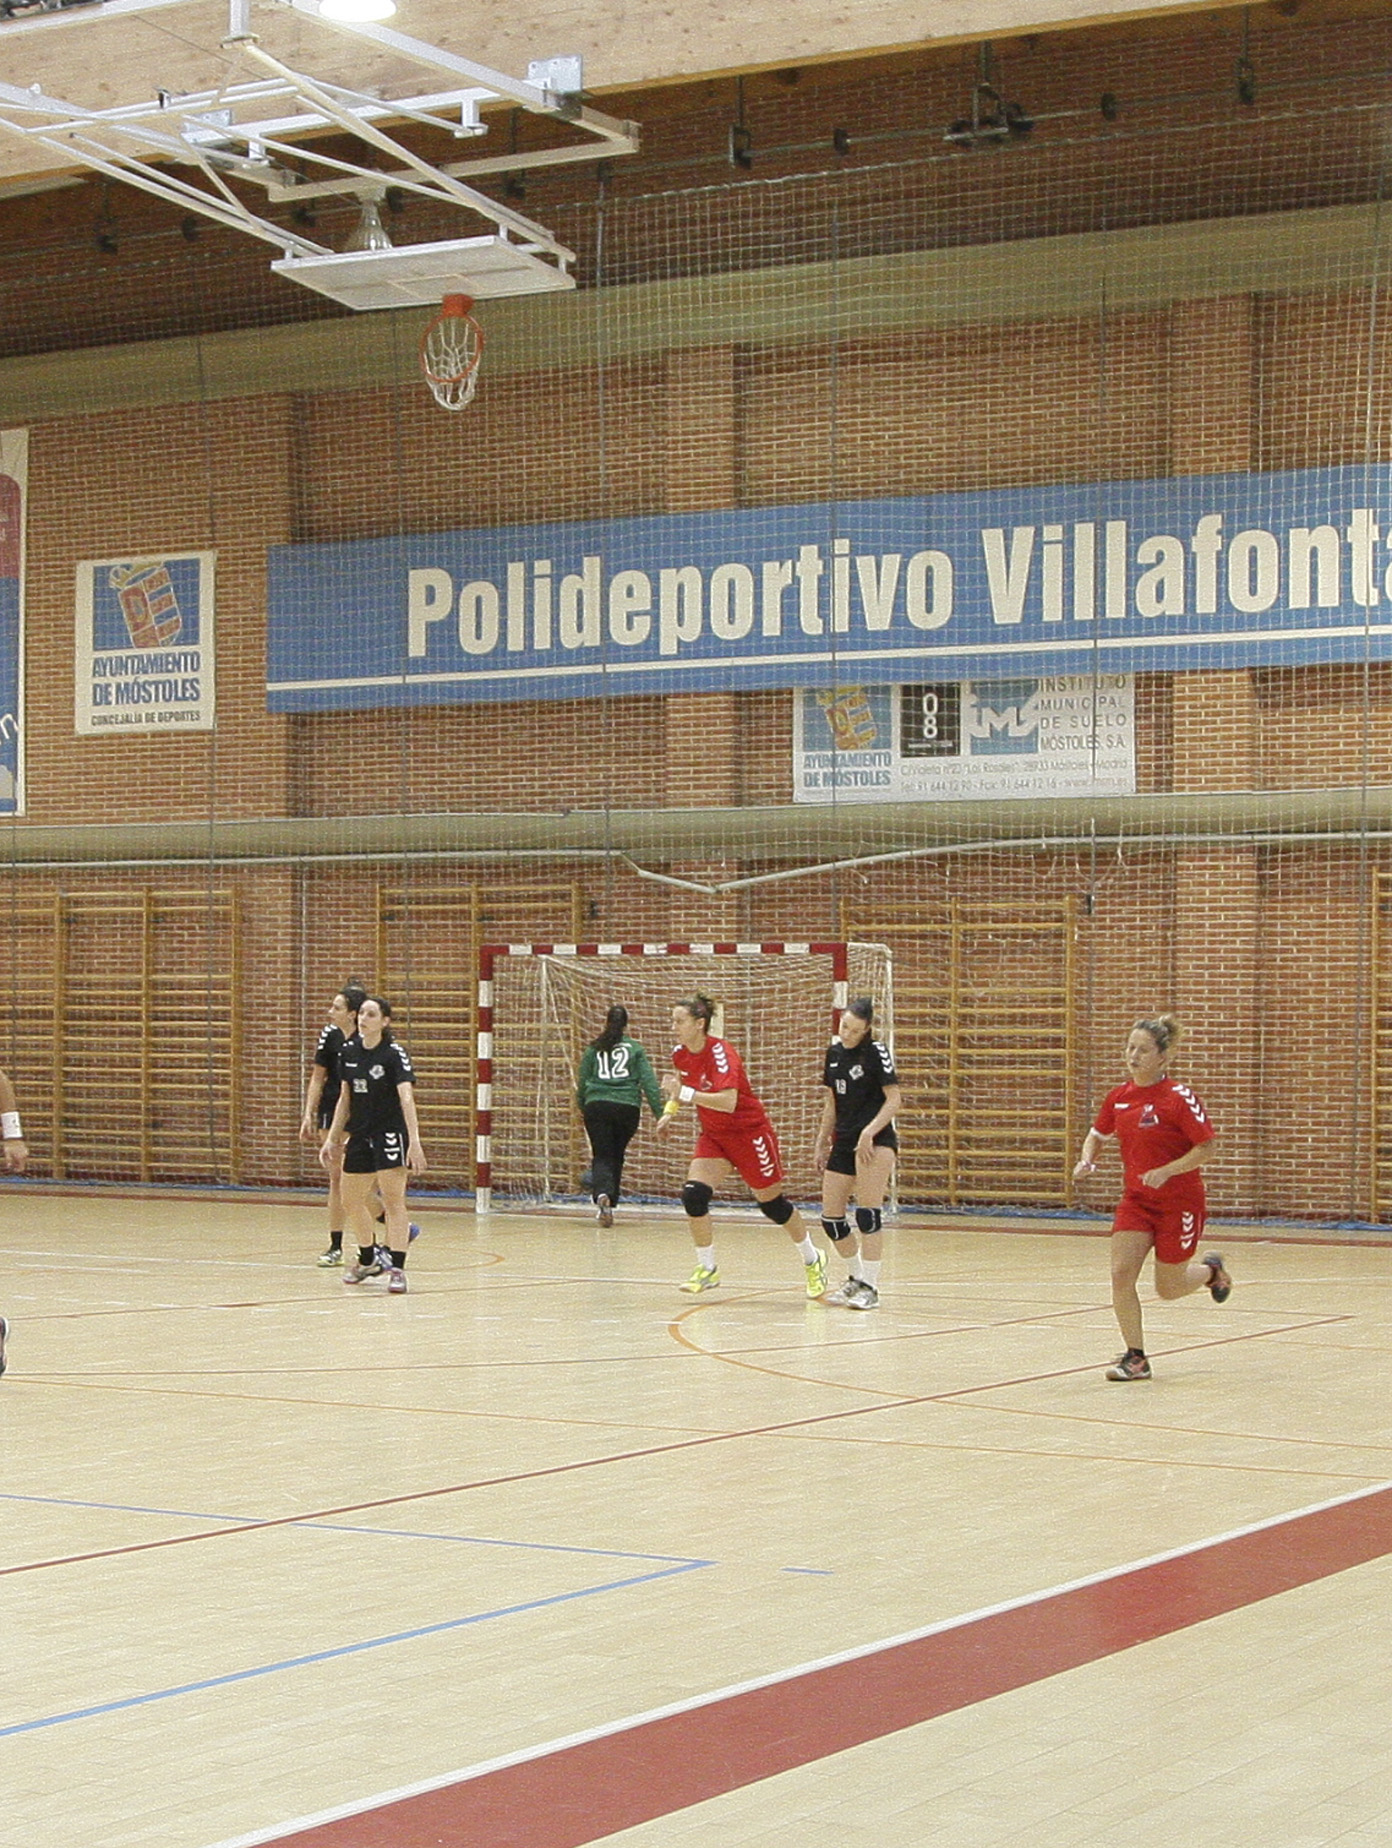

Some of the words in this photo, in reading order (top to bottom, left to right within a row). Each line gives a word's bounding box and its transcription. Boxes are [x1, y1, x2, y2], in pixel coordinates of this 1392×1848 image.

[408, 538, 953, 657] Polideportivo
[981, 508, 1392, 625] Villafont
[92, 651, 201, 678] AYUNTAMIENTO
[92, 682, 112, 706] DE
[115, 676, 200, 705] MÓSTOLES
[1040, 696, 1126, 711] MUNICPAL
[145, 712, 156, 723] DE
[158, 710, 201, 723] DEPORTES
[1040, 717, 1060, 729] DE
[1070, 713, 1127, 728] SUELO
[804, 752, 892, 769] AYUNTAMIENTO
[803, 772, 821, 787] DE
[822, 768, 891, 787] MÓSTOLES
[596, 1047, 630, 1079] 12
